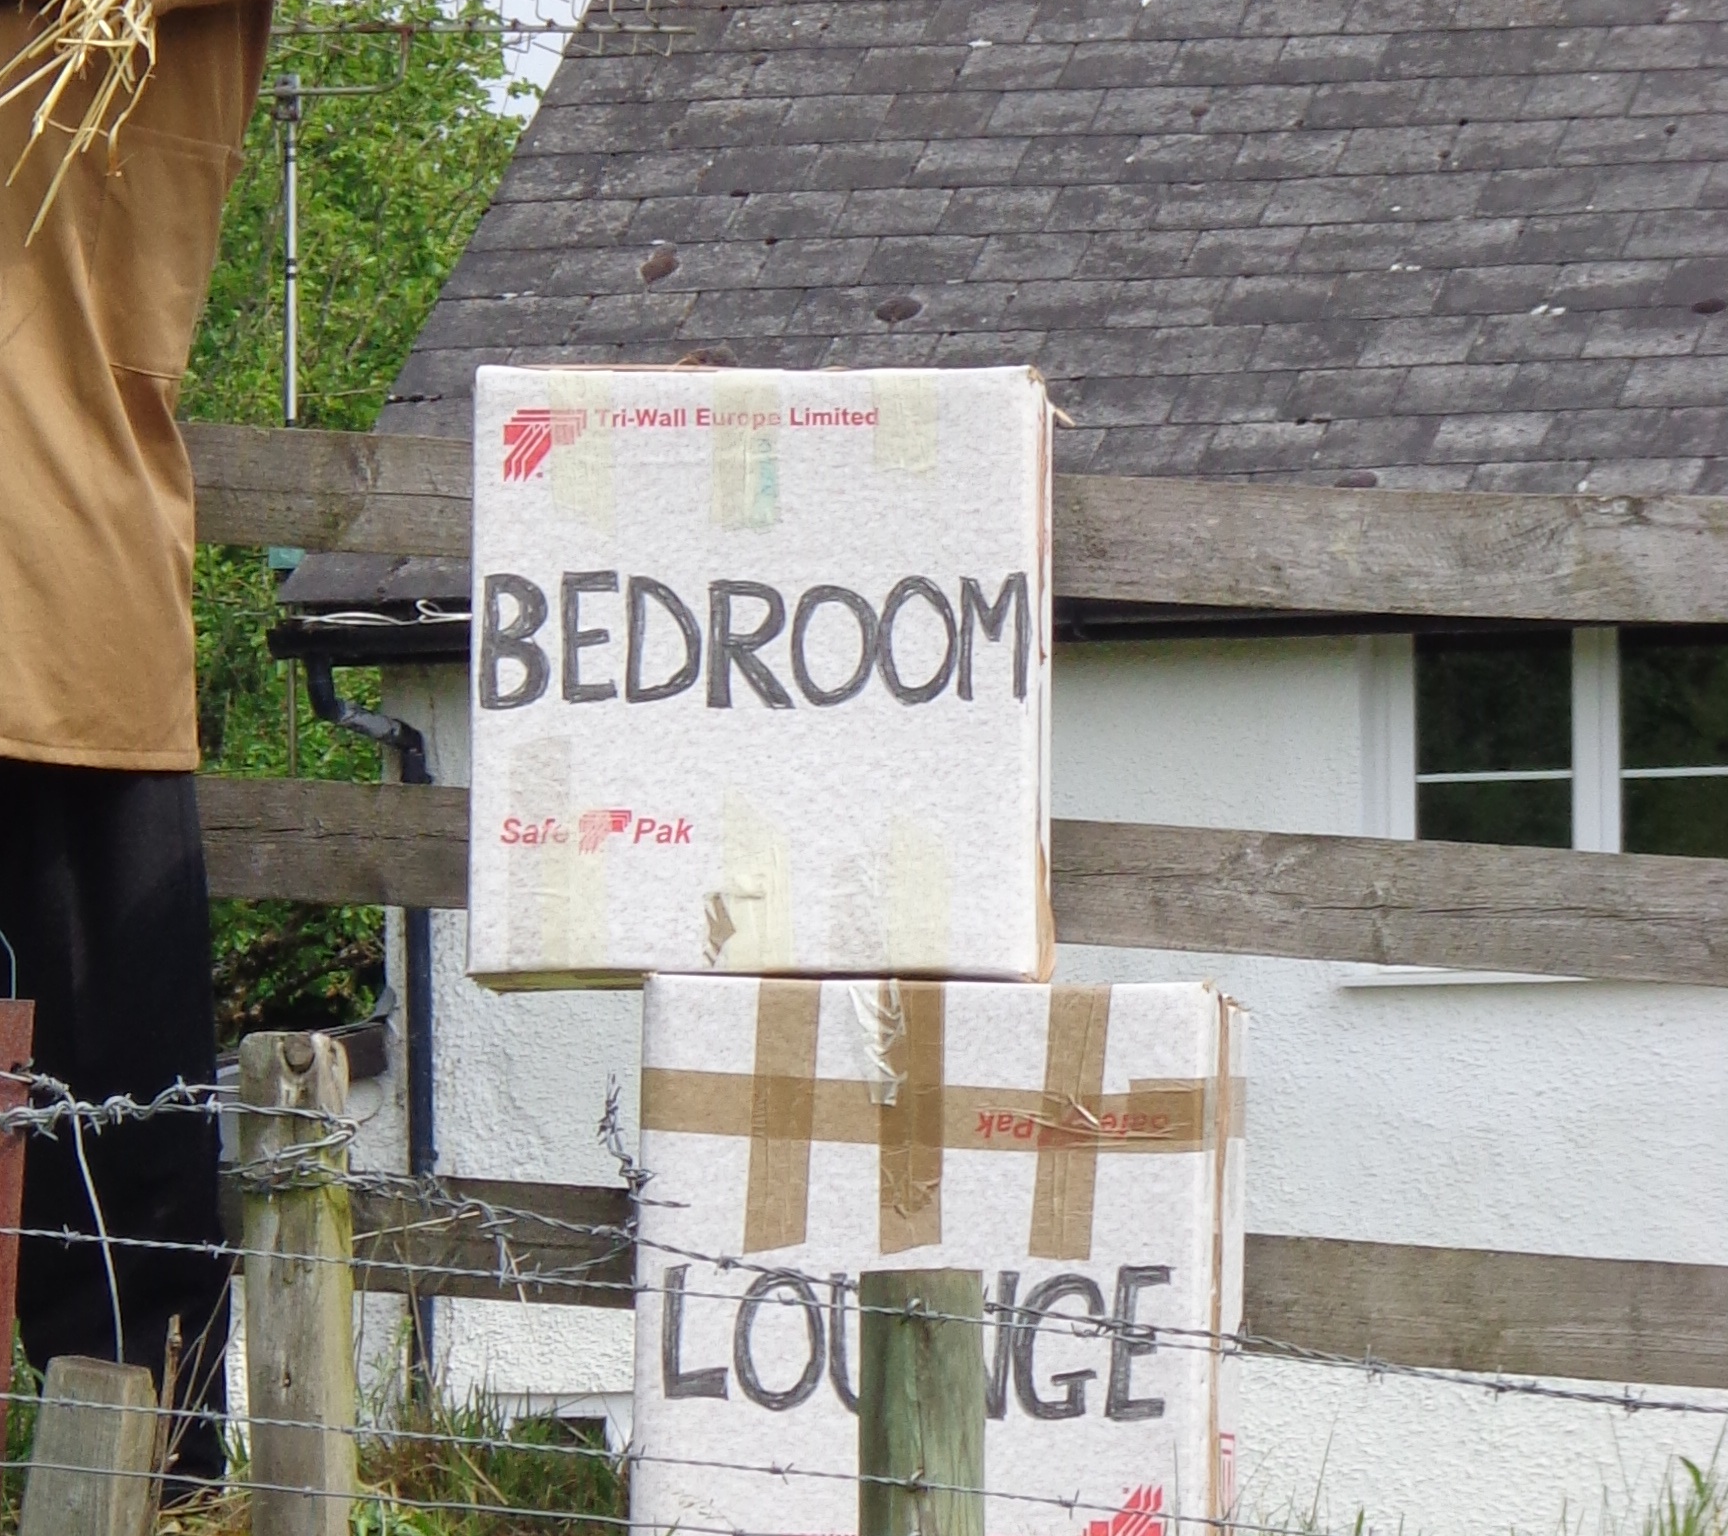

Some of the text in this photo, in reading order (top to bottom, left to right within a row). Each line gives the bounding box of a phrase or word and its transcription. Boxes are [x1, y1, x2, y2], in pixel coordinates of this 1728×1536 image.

[597, 407, 879, 430] Tri-Wall Europe Limited
[479, 570, 1032, 709] BEDROOM
[500, 817, 694, 845] Safe Pak
[975, 1111, 1037, 1139] Pak
